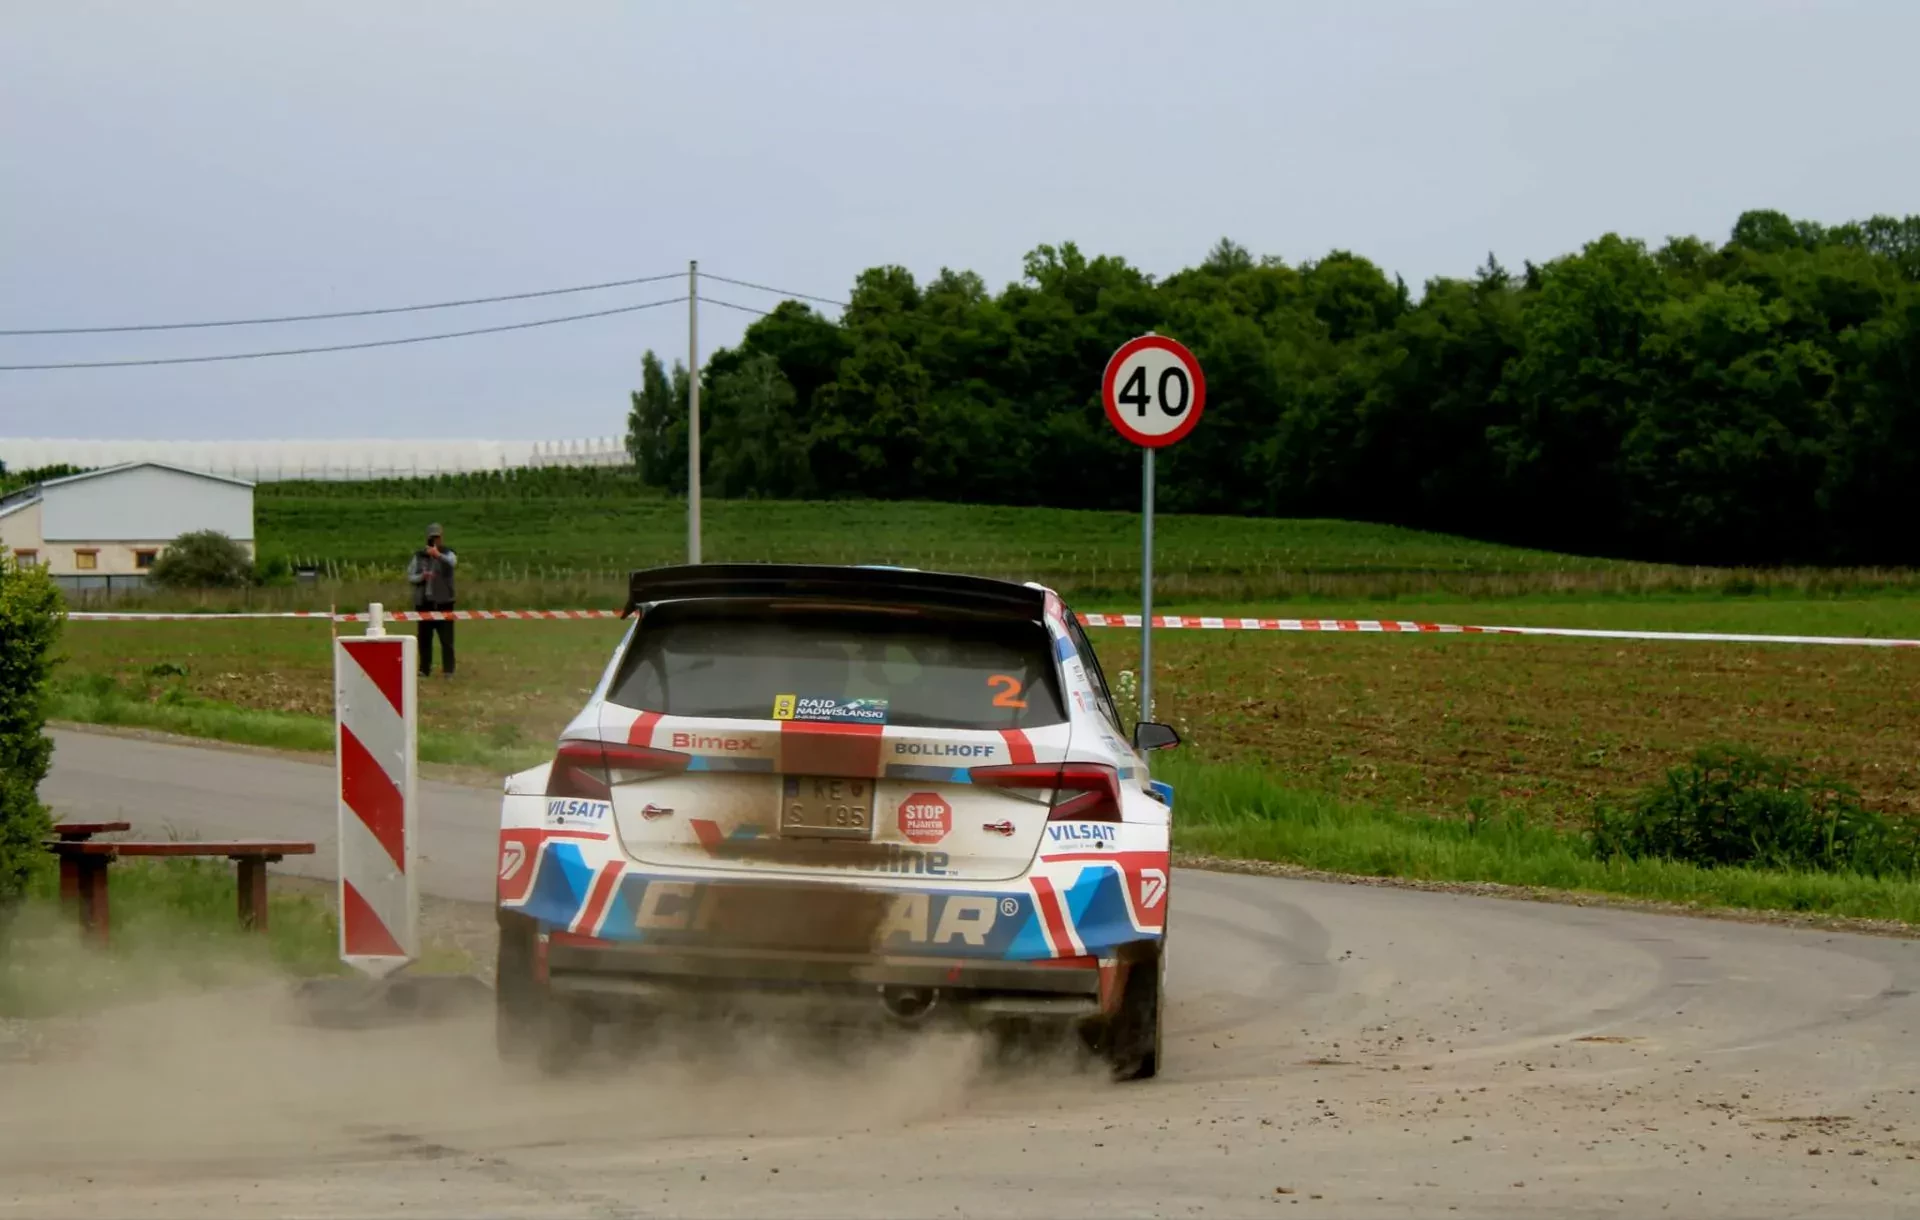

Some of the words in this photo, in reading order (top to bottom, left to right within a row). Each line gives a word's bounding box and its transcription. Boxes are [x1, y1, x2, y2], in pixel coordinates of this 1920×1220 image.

[1118, 366, 1189, 417] 40
[987, 674, 1027, 708] 2
[799, 698, 835, 709] RAJD
[672, 732, 760, 752] Bimex
[813, 779, 844, 801] KE
[547, 800, 609, 819] VILSAIT
[824, 803, 866, 827] 195
[905, 804, 945, 819] STOP
[1048, 824, 1116, 841] VILSAIT
